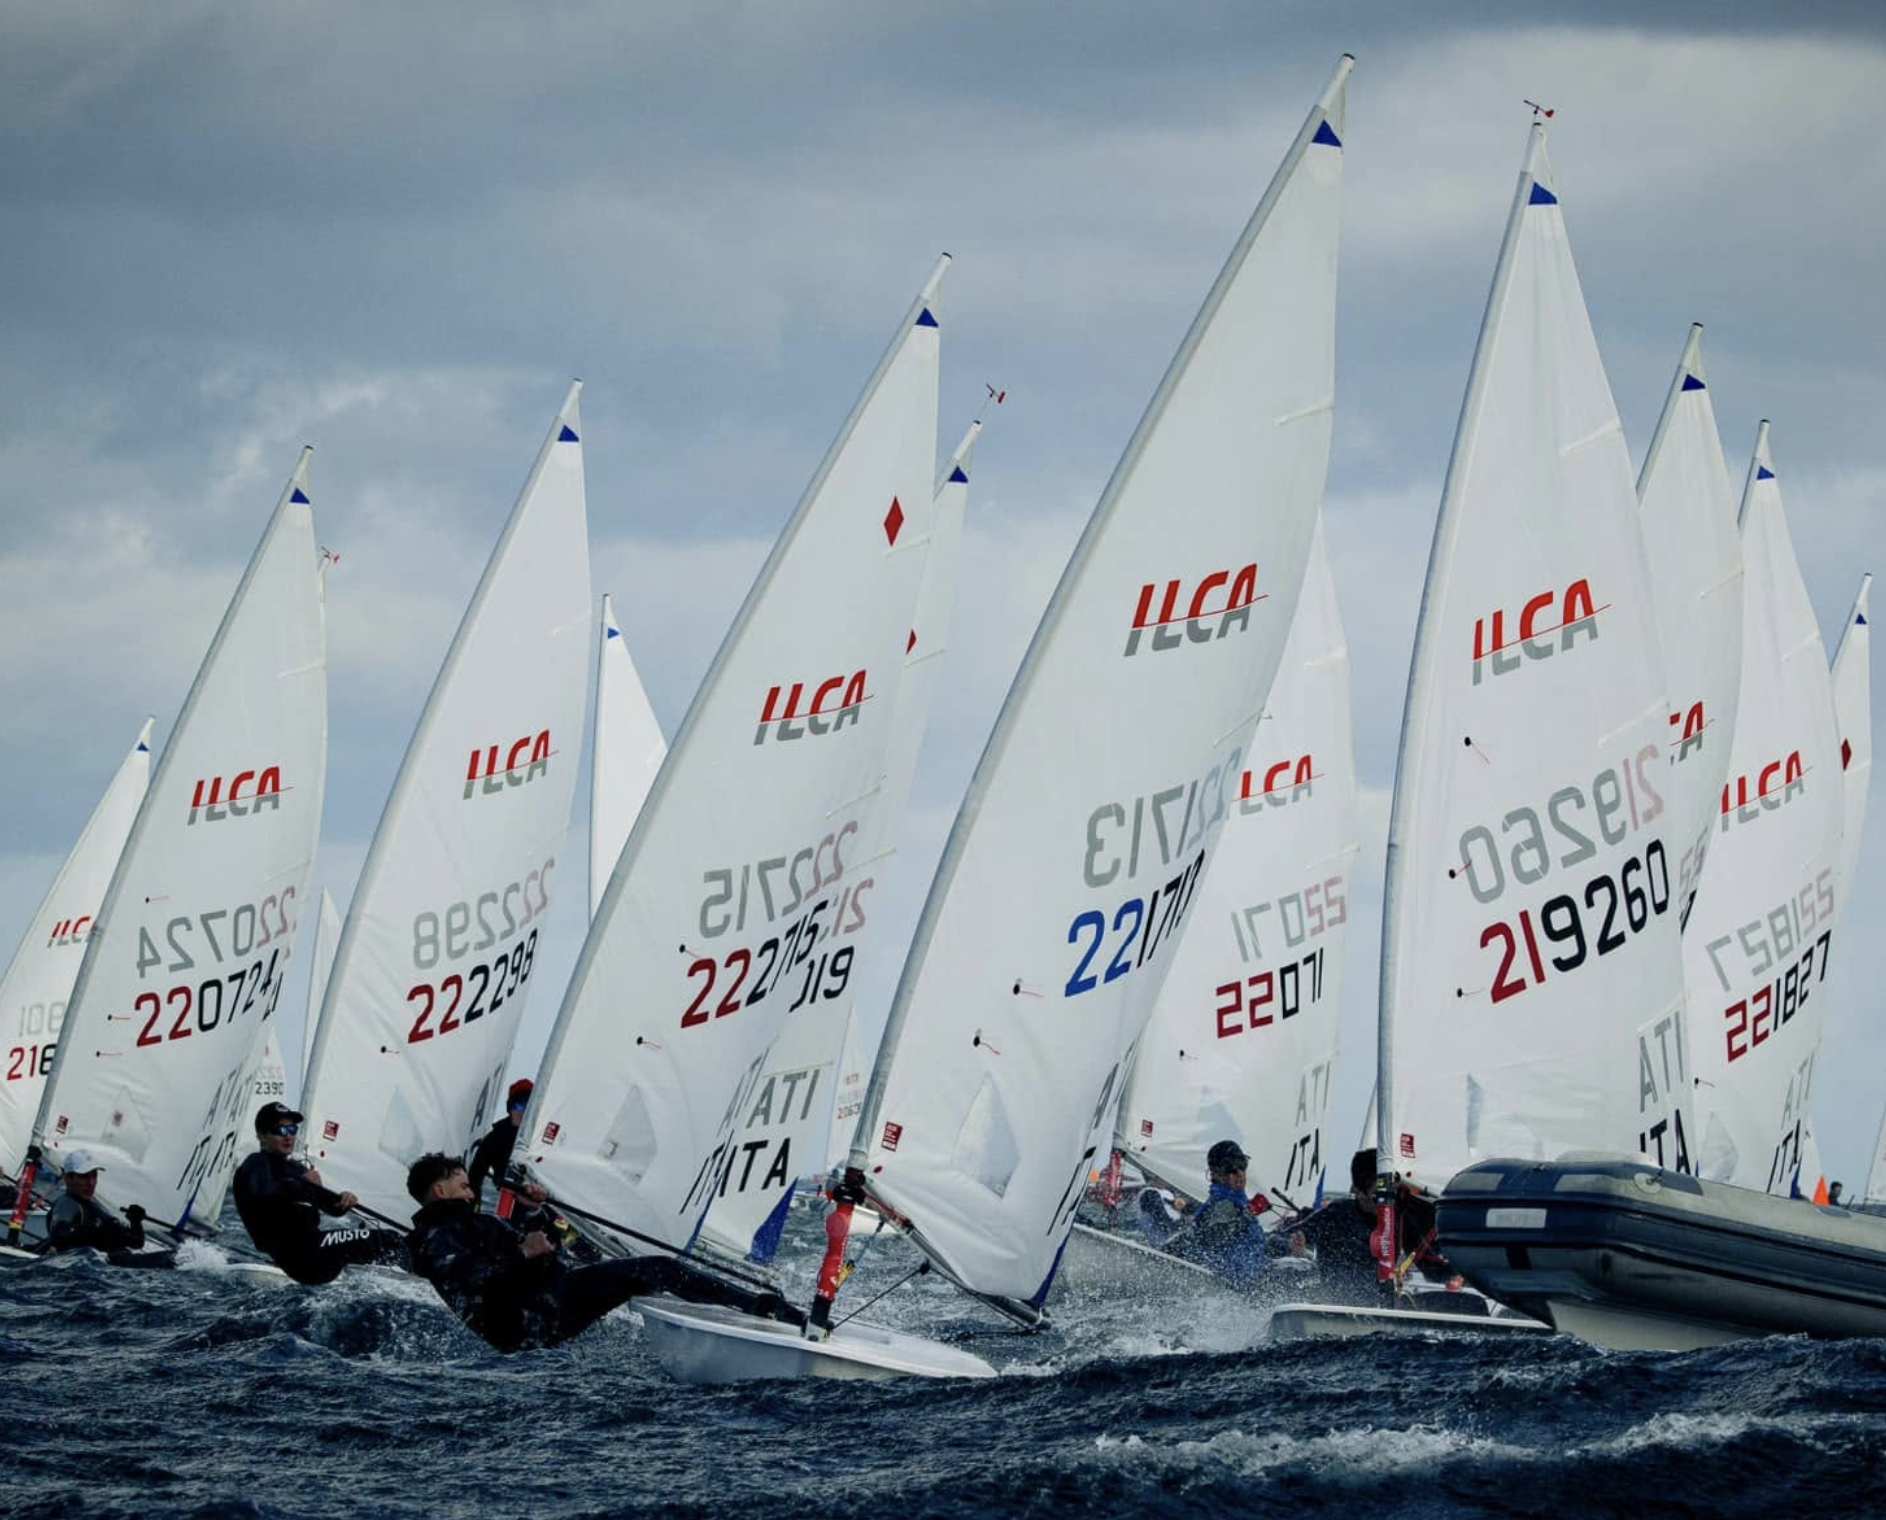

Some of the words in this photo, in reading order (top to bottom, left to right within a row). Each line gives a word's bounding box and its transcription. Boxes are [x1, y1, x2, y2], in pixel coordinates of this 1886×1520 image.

[1123, 563, 1260, 657] ILCA
[1473, 578, 1600, 686] ILCA
[753, 669, 870, 746] ILCA
[187, 766, 282, 826] ILCA
[463, 729, 553, 800] ILCA
[1240, 754, 1315, 816] LCA
[1721, 750, 1805, 832] ILCA
[47, 916, 97, 948] ILC
[1479, 839, 1670, 1004] 219260
[134, 948, 280, 1048] 220724
[407, 928, 538, 1045] 222298
[1216, 947, 1324, 1039] 22071
[1725, 929, 1831, 1063] 221827
[719, 1137, 791, 1198] ITA
[1284, 1128, 1319, 1191] ITA
[1640, 1108, 1691, 1176] TA
[320, 1229, 370, 1247] MUSTO
